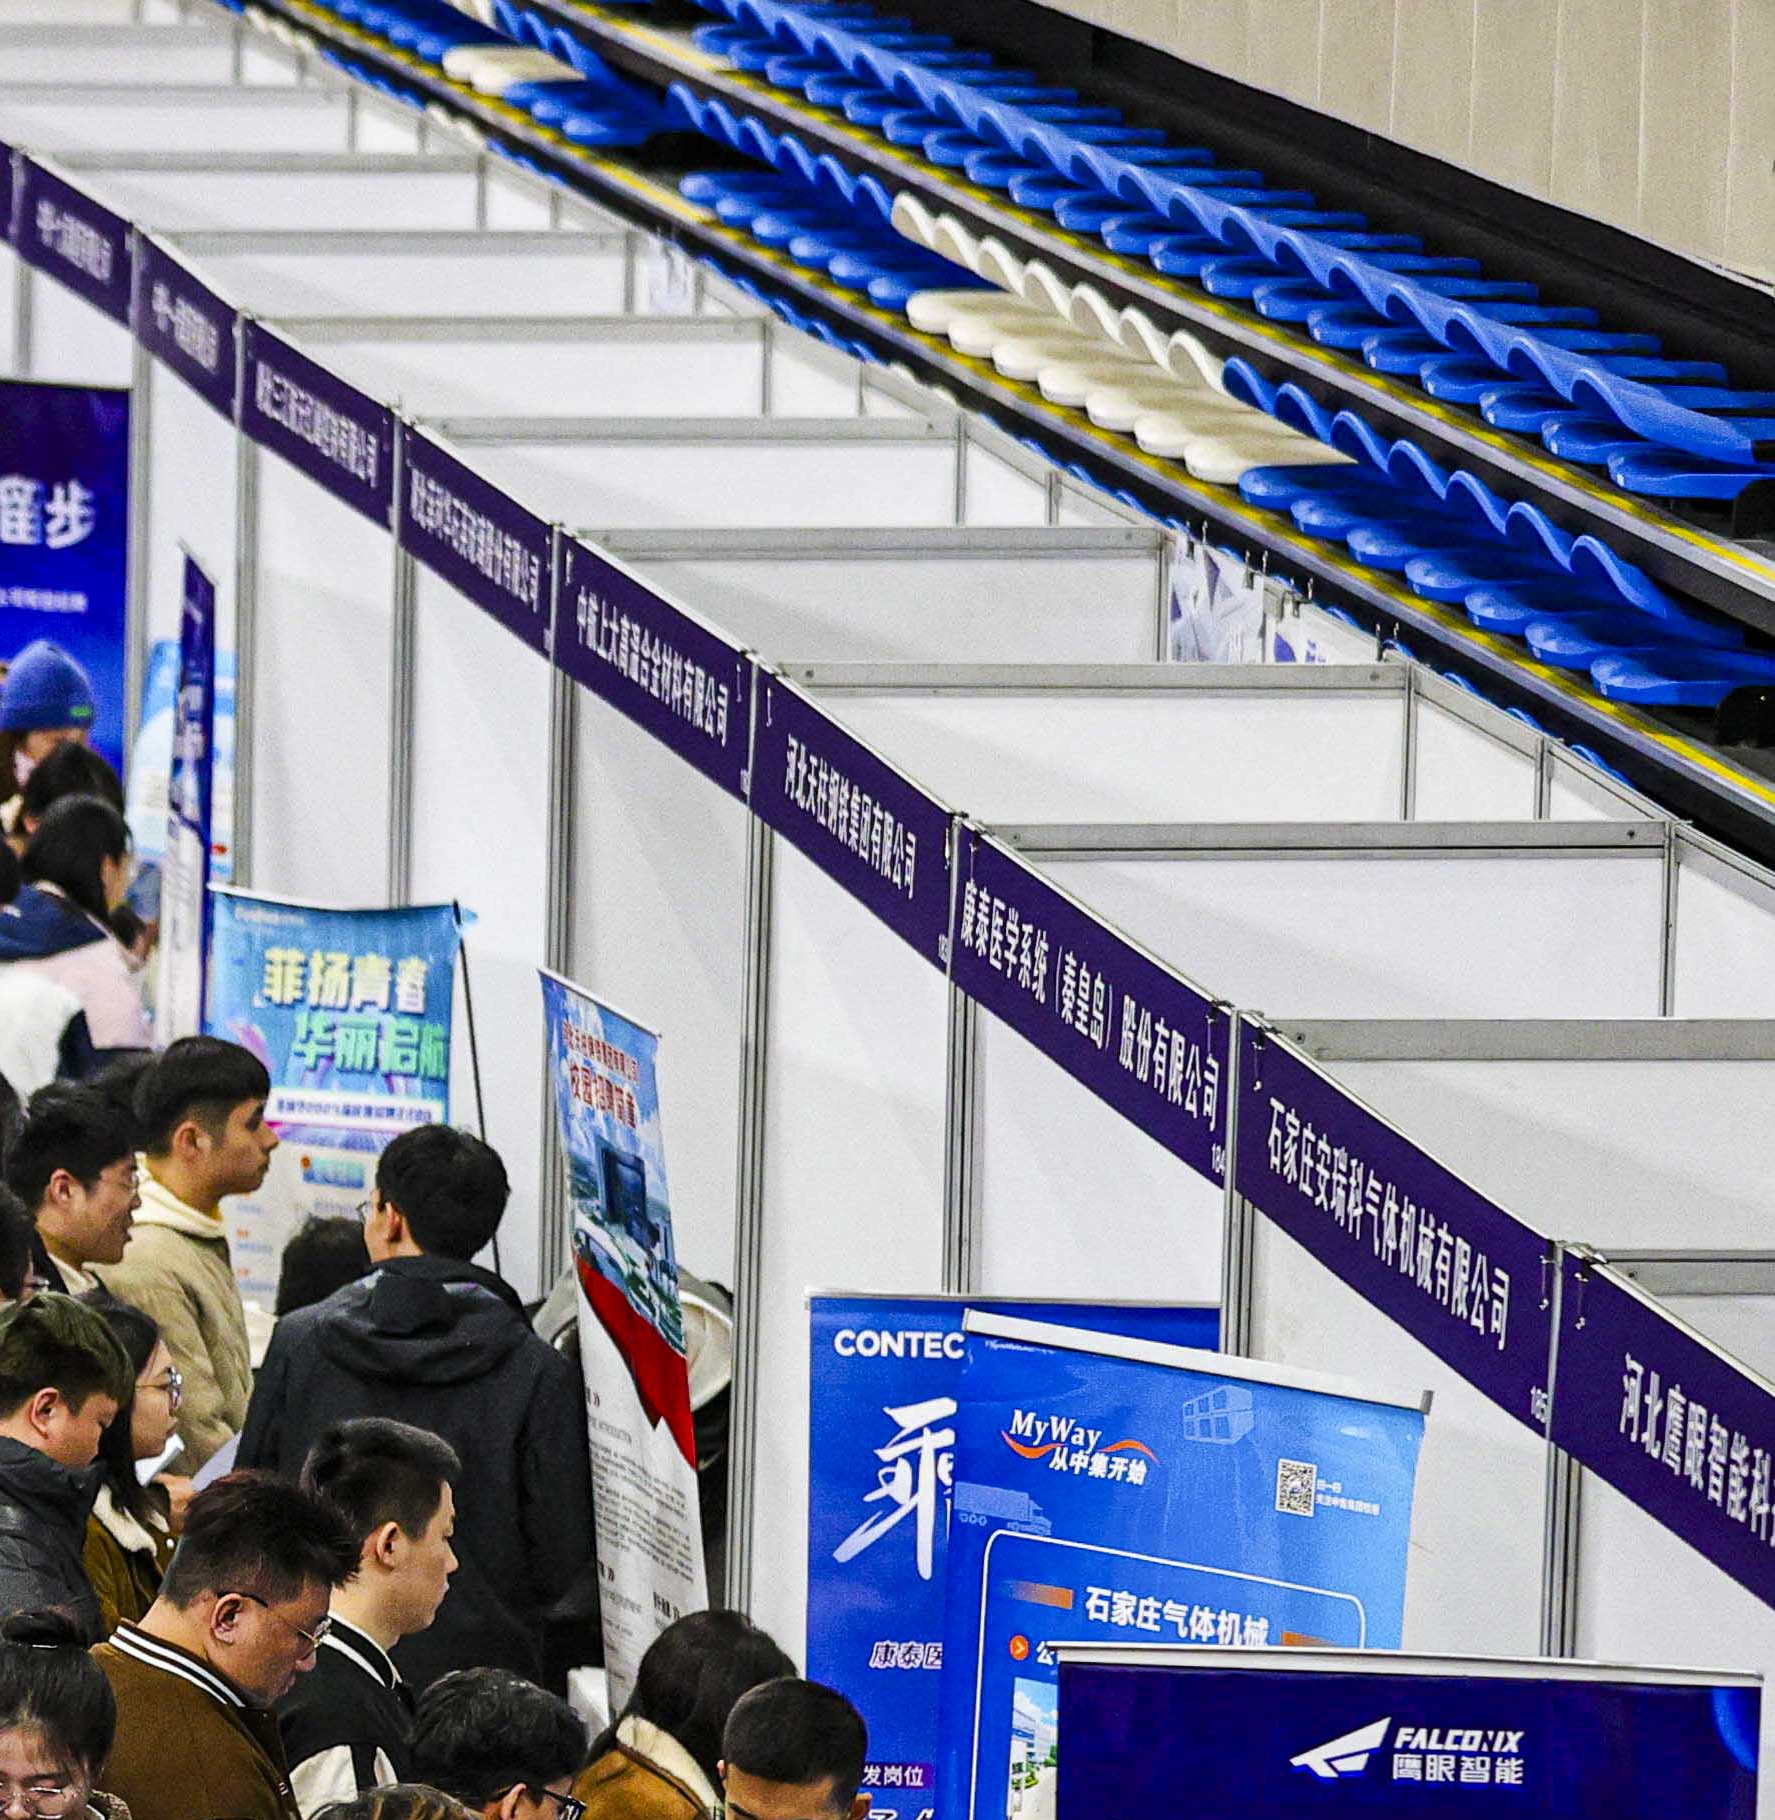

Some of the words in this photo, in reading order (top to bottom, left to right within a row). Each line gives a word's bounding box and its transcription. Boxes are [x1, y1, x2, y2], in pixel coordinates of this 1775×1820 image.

[576, 585, 728, 746] 中航上大高温合金材料有限公司
[784, 734, 917, 899] 河北天柱钢铁集团有限公司
[263, 947, 427, 1014] 菲扬青春
[291, 1011, 448, 1079] 华丽启航
[1268, 1097, 1510, 1350] 石家庄安瑞科气体机械有限公司
[834, 1328, 965, 1360] CONTEC
[1010, 1408, 1102, 1454] MyWay
[1619, 1352, 1775, 1549] 河北鹰眼智能科
[1048, 1447, 1148, 1486] 从中集开始
[1085, 1585, 1271, 1646] 石家庄气体机械
[1036, 1641, 1058, 1664] 公
[1392, 1753, 1525, 1785] 鹰眼智能
[1394, 1727, 1524, 1753] FALCONIX
